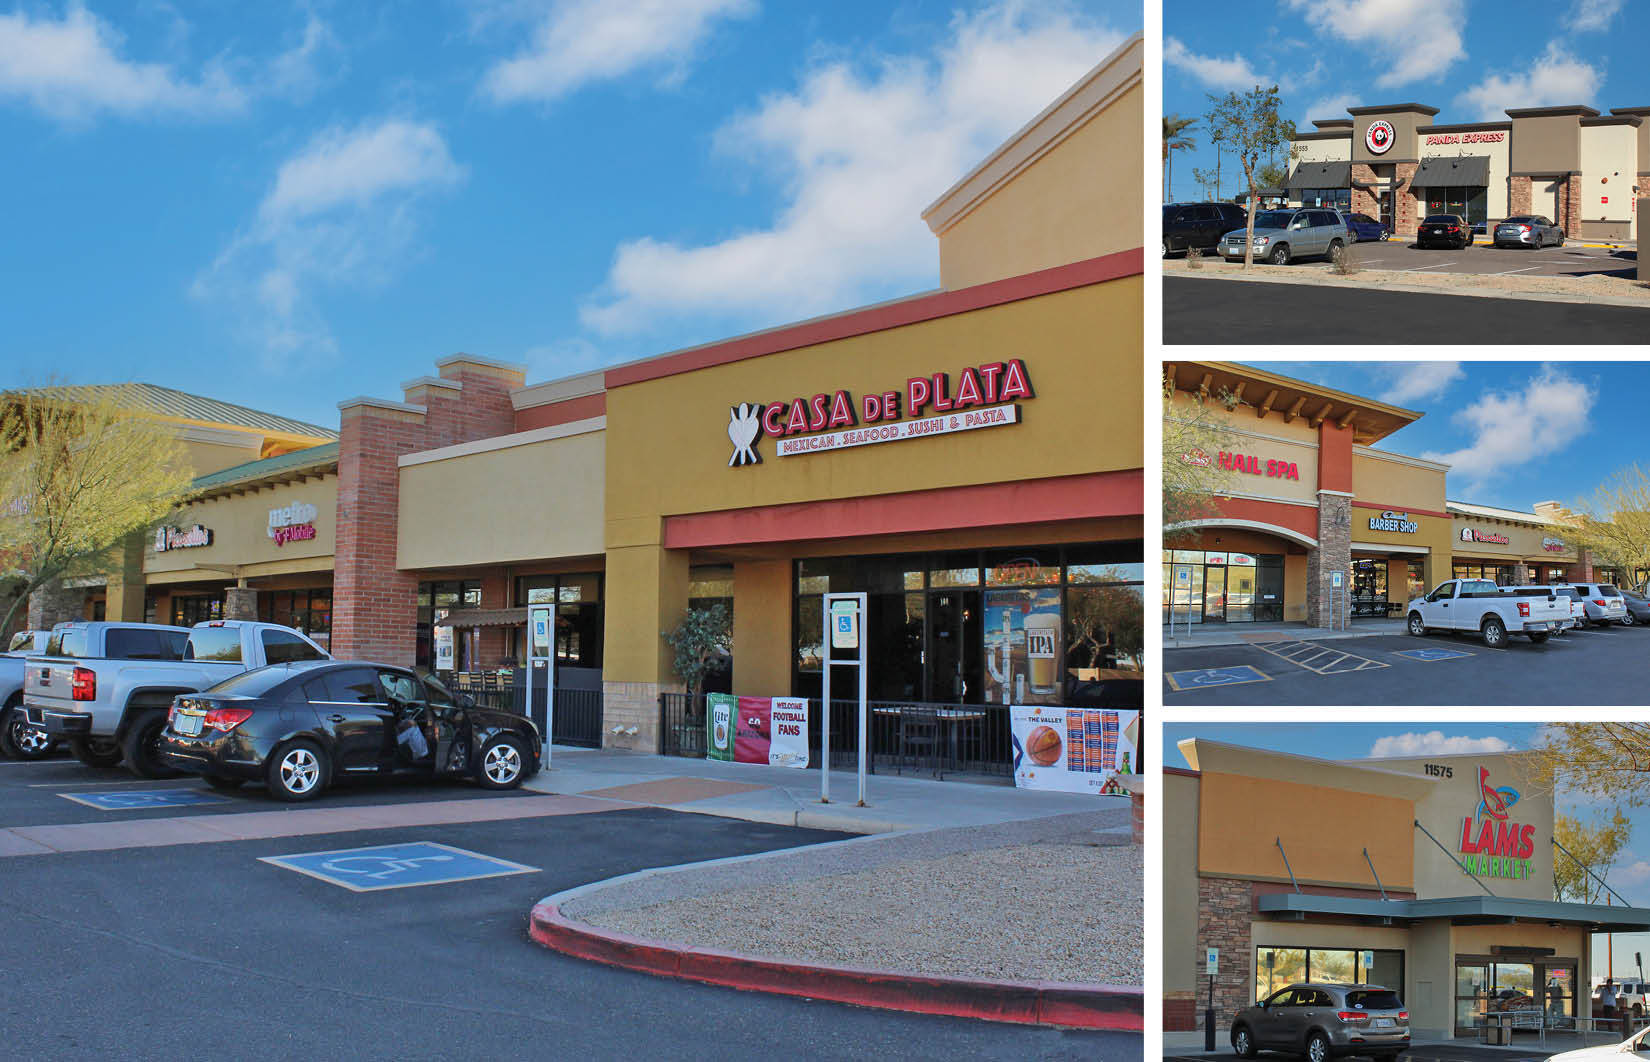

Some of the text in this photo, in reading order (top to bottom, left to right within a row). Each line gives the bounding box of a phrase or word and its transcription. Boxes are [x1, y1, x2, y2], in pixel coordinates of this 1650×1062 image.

[1426, 132, 1505, 145] PANDA EXPRESS
[762, 359, 1033, 437] CASA DE PLATA
[783, 437, 836, 453] MEXICAN
[843, 425, 899, 446] SEAFOOD
[907, 418, 945, 436] SUSHI
[964, 408, 1007, 428] PASTA
[1218, 451, 1299, 480] NAIL SPA
[1369, 518, 1418, 533] BARBER SHOP
[1029, 635, 1054, 654] IPA
[776, 702, 804, 710] WELCOME
[772, 712, 807, 722] FOOTBALL
[777, 724, 801, 737] FANS
[1424, 764, 1453, 778] 11575
[1459, 816, 1537, 860] LAMS
[1463, 855, 1532, 880] MARKET
